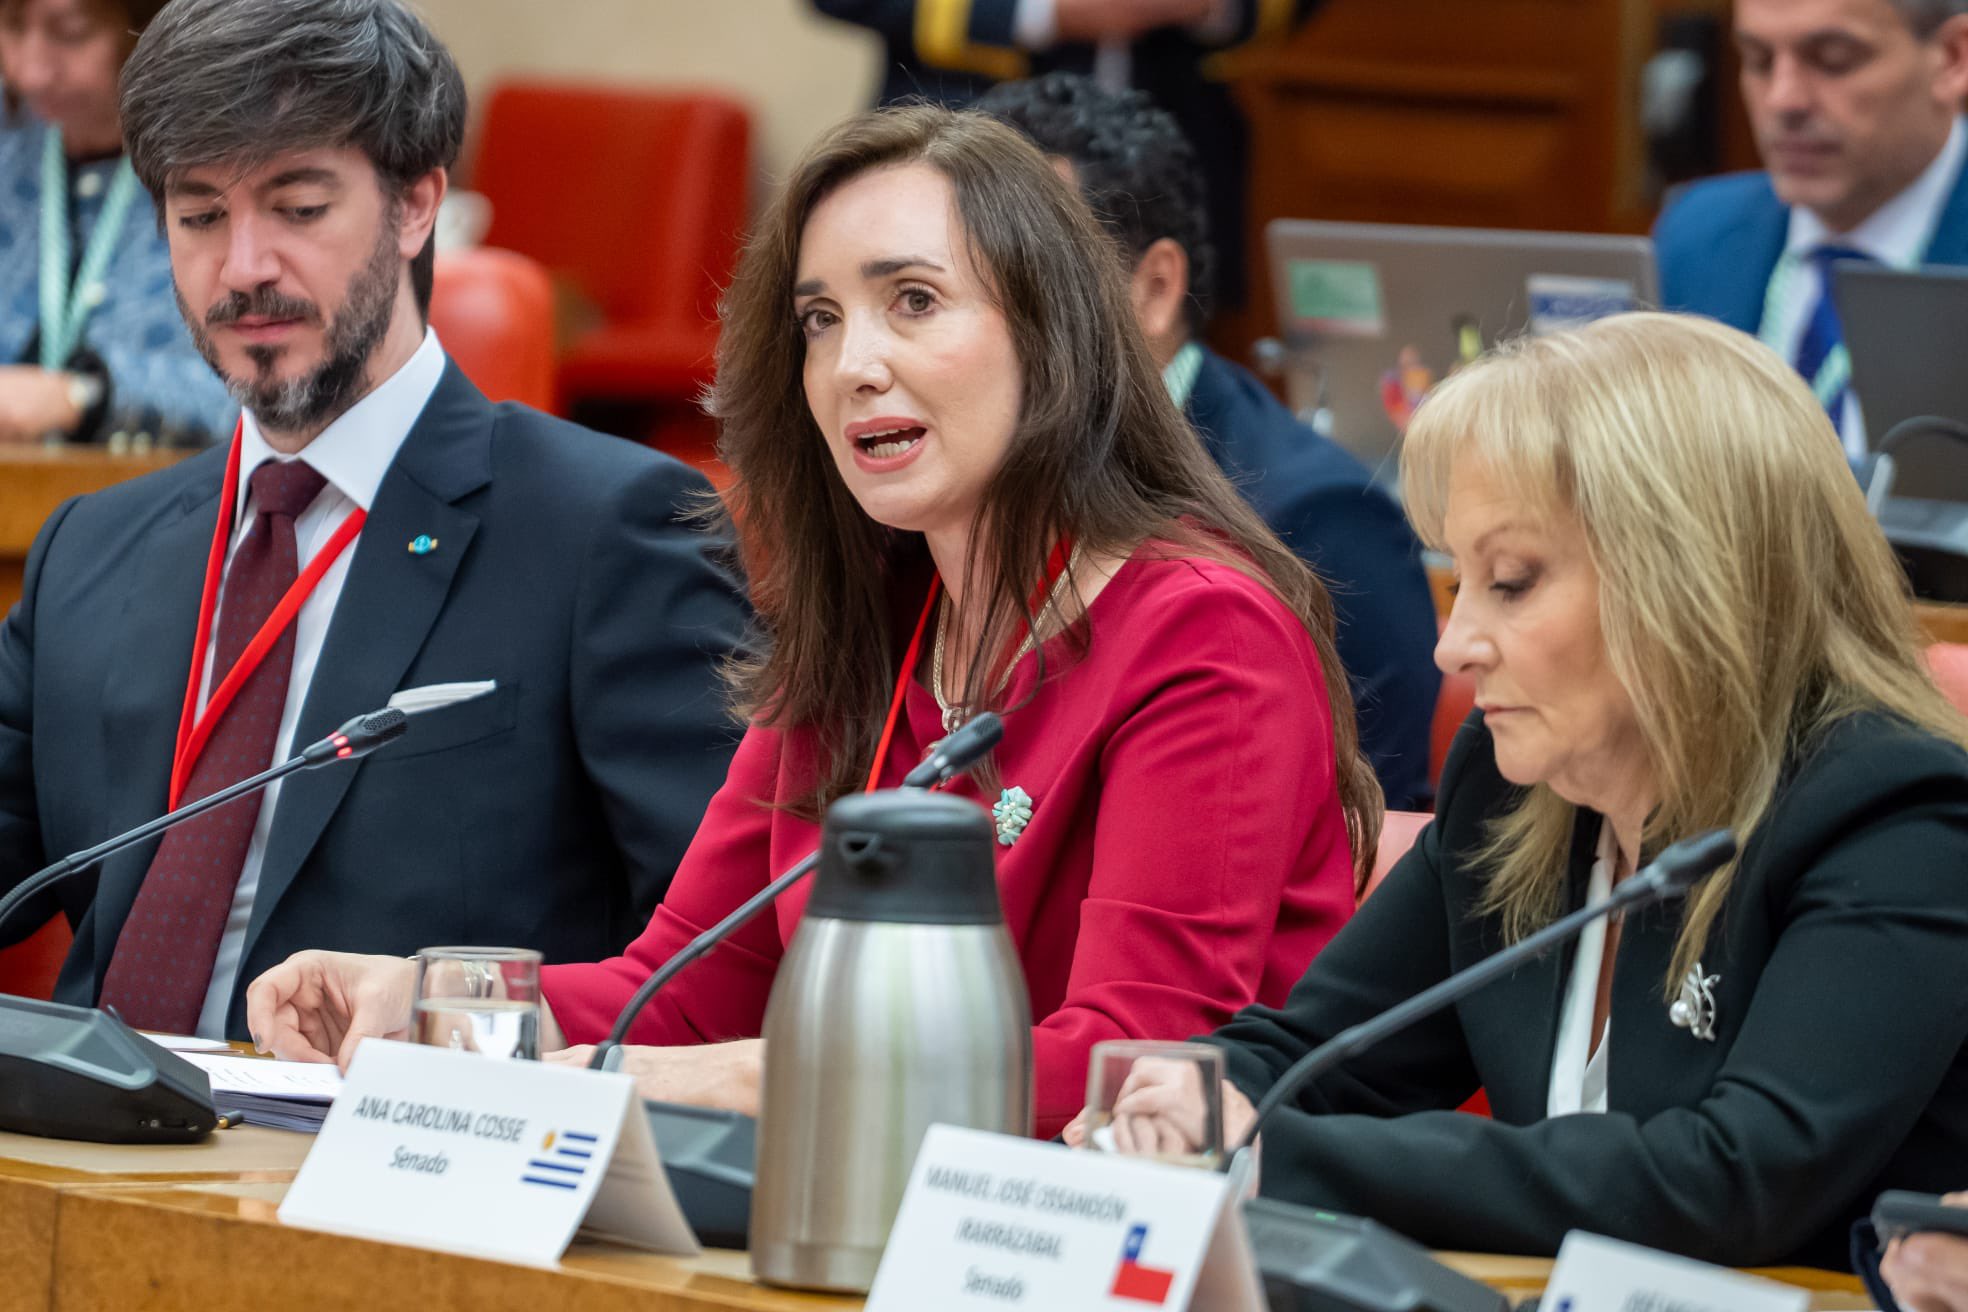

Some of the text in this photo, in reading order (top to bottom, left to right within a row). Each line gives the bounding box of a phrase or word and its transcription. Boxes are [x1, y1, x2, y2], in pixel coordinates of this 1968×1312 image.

[353, 1095, 527, 1142] ANA CAROLINA COSSE
[389, 1144, 450, 1174] Senado
[927, 1165, 992, 1199] MANUEL
[963, 1264, 1025, 1301] Senado
